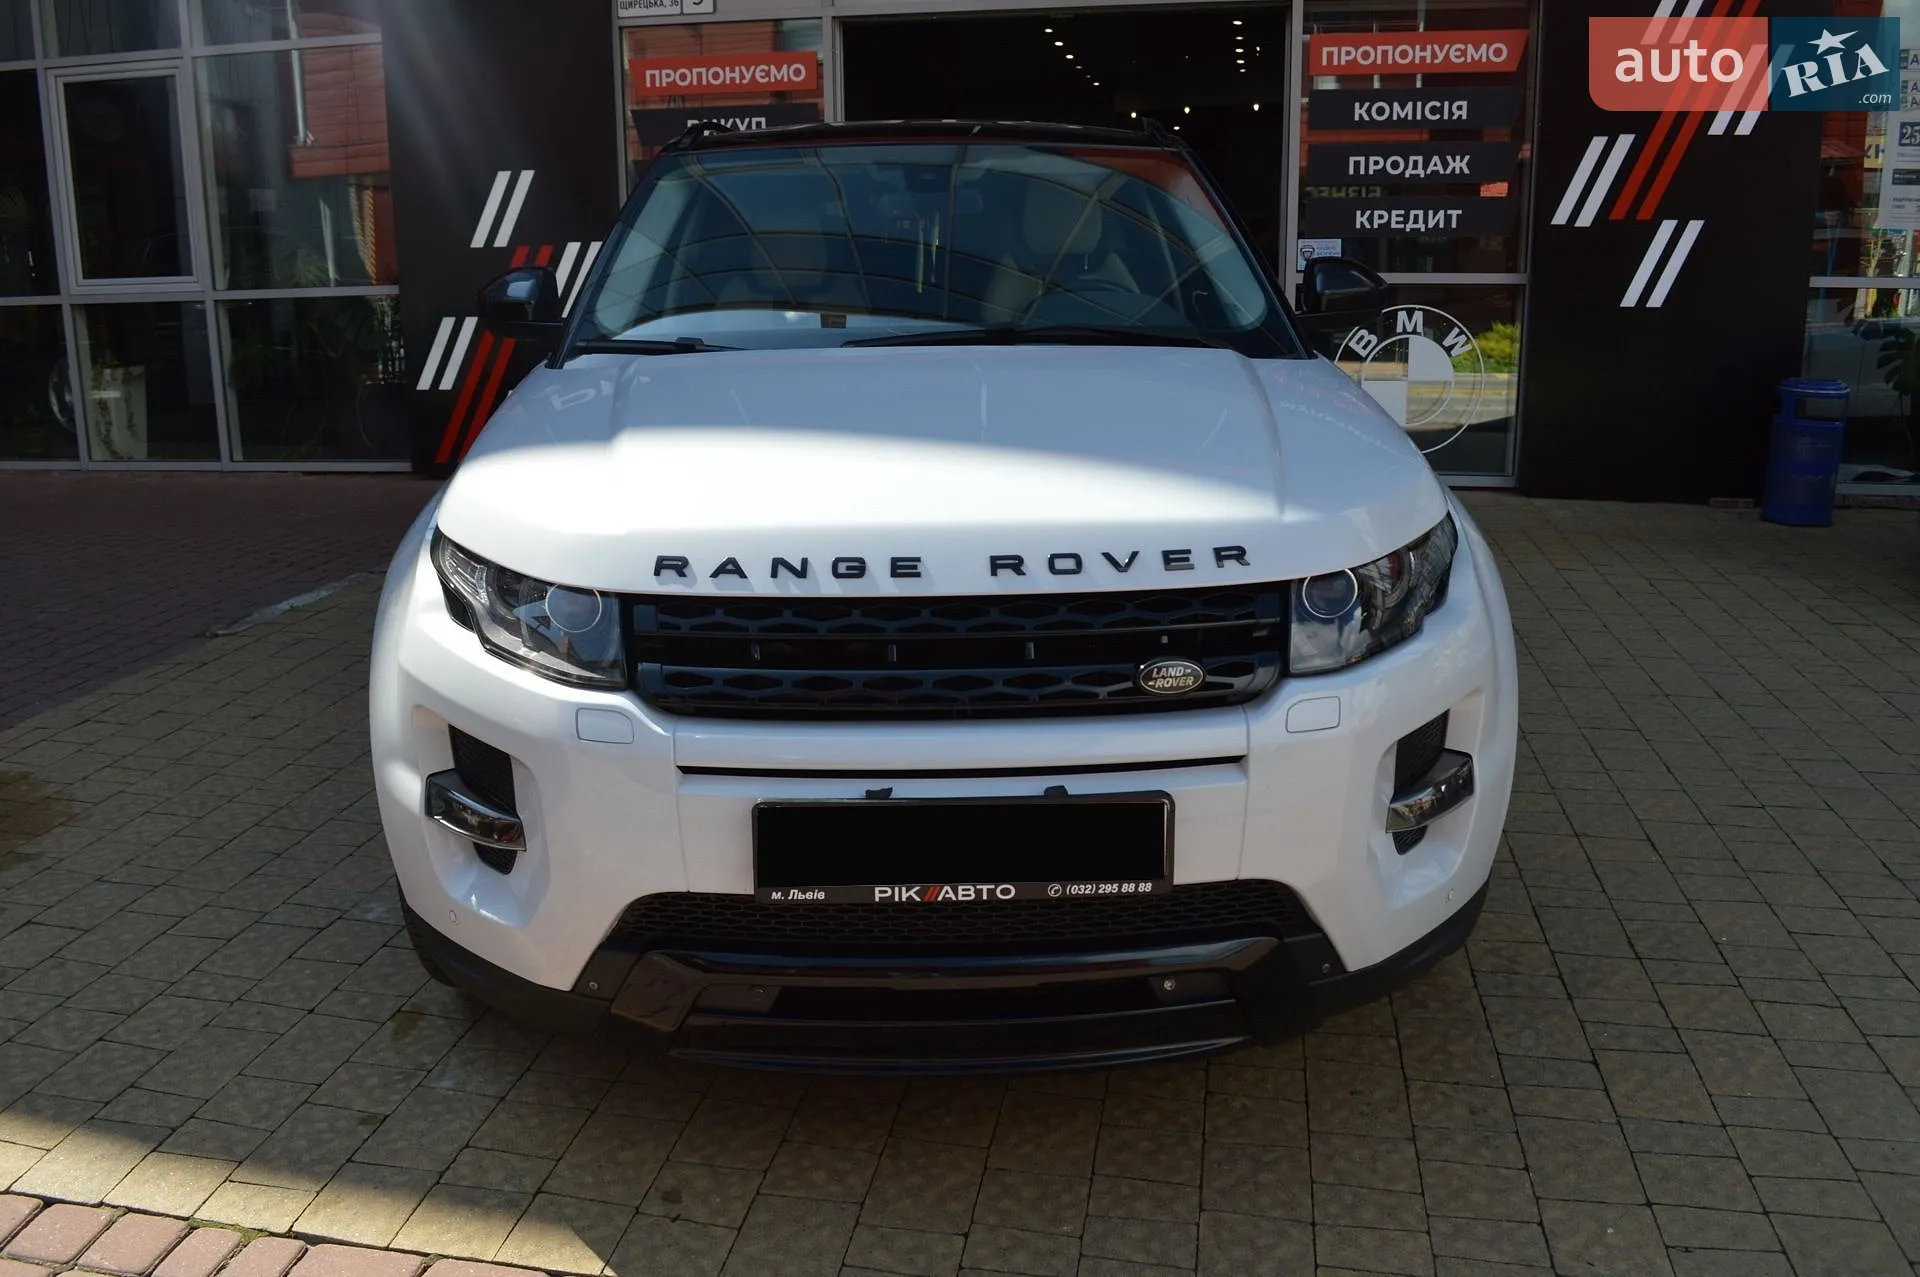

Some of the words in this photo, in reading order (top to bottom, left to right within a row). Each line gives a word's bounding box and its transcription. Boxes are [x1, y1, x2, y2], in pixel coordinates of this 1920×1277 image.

[1320, 42, 1509, 67] ПРОПОНУЄМО
[644, 63, 807, 88] ПРОПОНУЄМО
[1353, 100, 1468, 122] КОМІСІЯ
[1348, 154, 1471, 179] ПРОДАЖ
[1354, 209, 1463, 232] КРЕДИТ
[1348, 310, 1473, 358] BMW
[653, 555, 923, 579] RANGE
[985, 545, 1251, 577] ROVER
[1152, 667, 1184, 678] LAND
[1155, 676, 1194, 688] ROVER
[787, 889, 826, 901] Львів
[1066, 884, 1095, 896] (032)
[1098, 884, 1118, 894] 295
[1121, 883, 1135, 893] 88
[1138, 882, 1153, 892] 88
